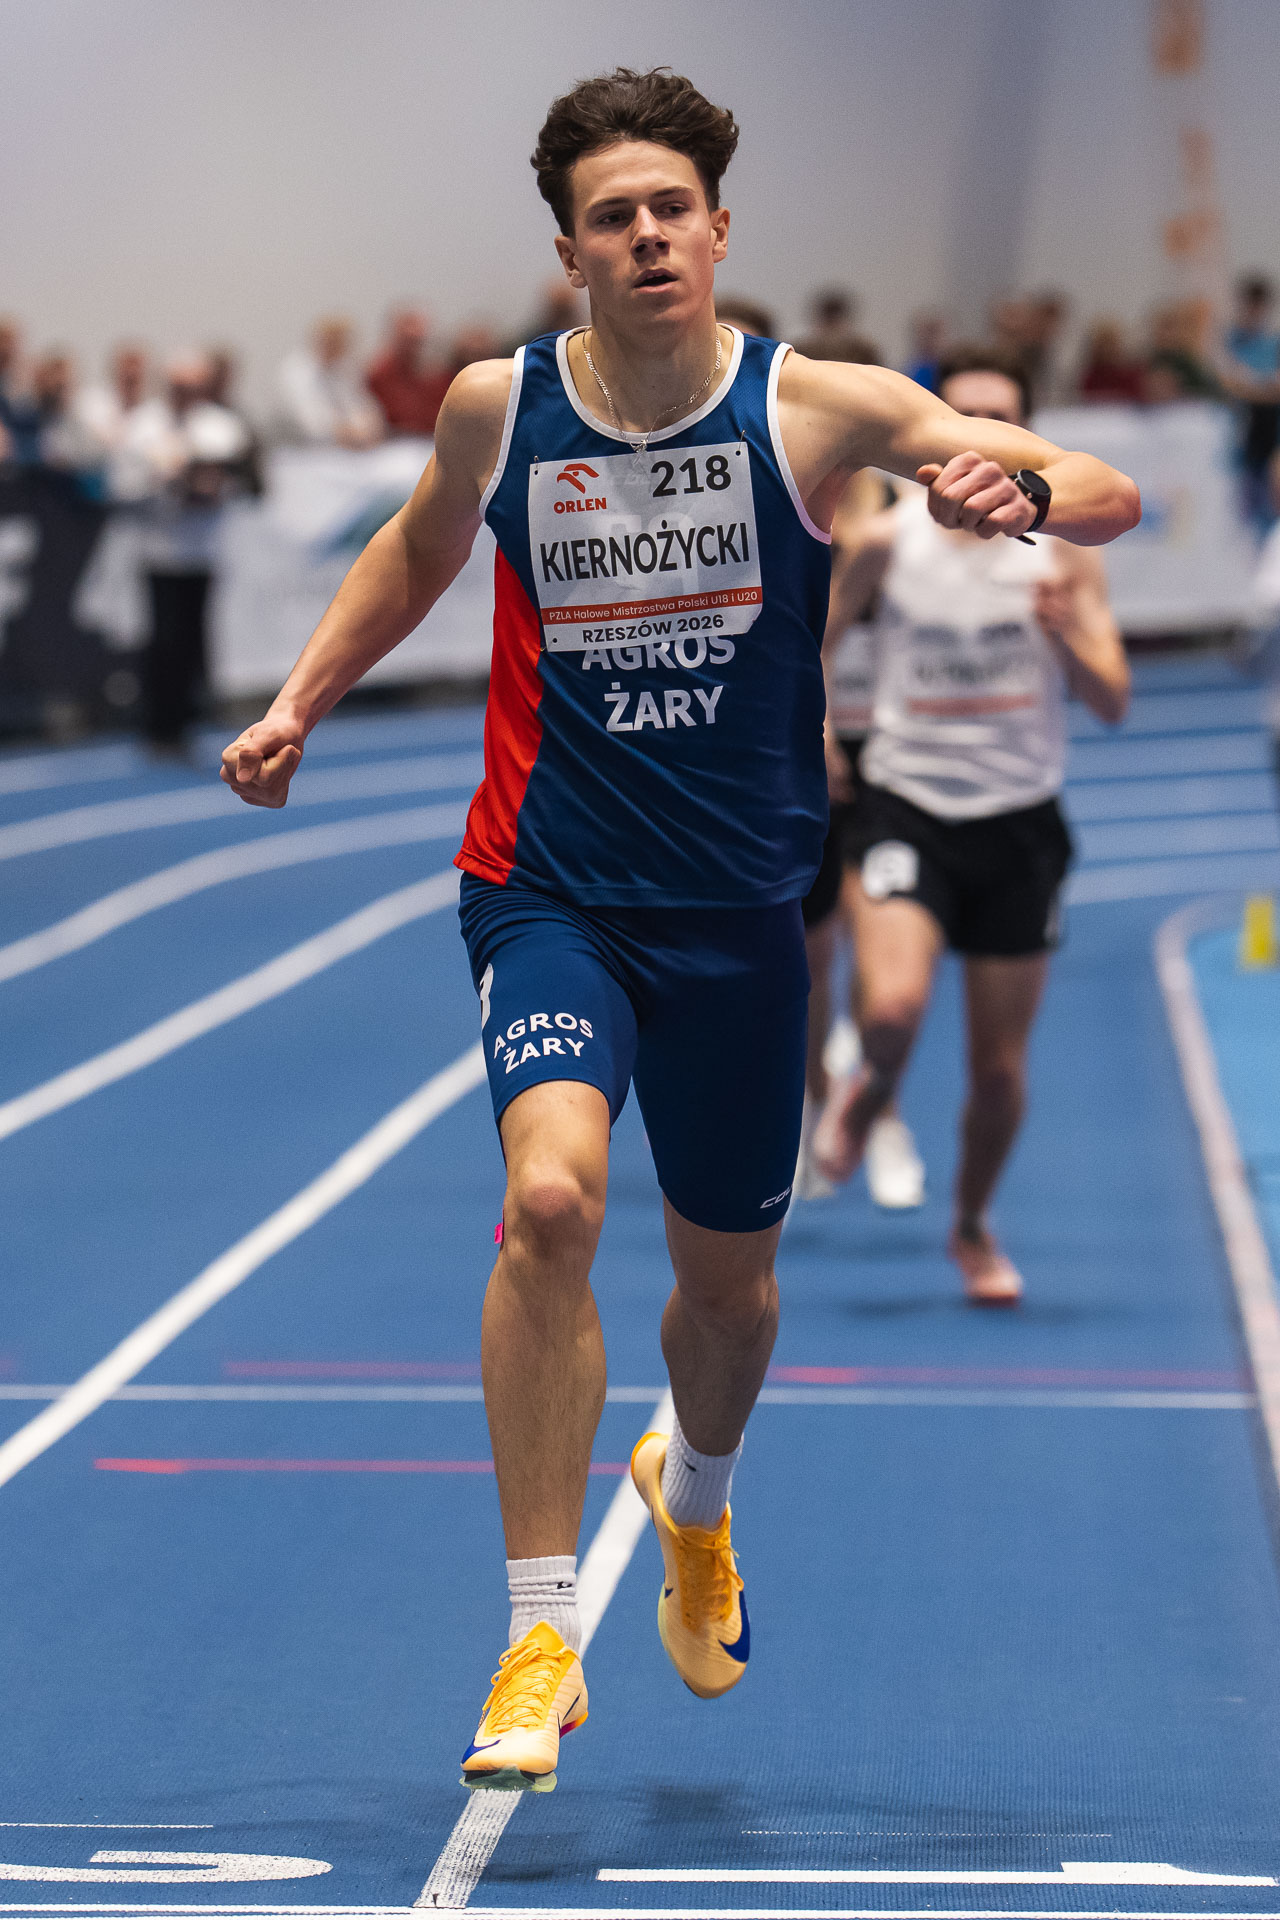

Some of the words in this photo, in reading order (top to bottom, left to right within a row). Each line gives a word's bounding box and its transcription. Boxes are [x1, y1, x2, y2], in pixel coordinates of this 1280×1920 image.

[651, 455, 731, 497] 218
[553, 497, 607, 514] ORLEN
[540, 520, 750, 582] KIERNOŻYCKI
[549, 611, 571, 620] PZLA
[574, 609, 610, 619] Halowe
[613, 602, 675, 616] Mistrzostwa
[678, 596, 708, 609] Polski
[711, 594, 729, 605] U18
[731, 593, 735, 602] i
[737, 591, 758, 602] U20
[582, 620, 672, 643] RZESZÓW
[677, 614, 724, 633] 2026
[582, 635, 736, 671] AGROS
[604, 681, 724, 732] ŻARY
[494, 1012, 594, 1059] AGROS
[503, 1037, 585, 1074] ŻARY
